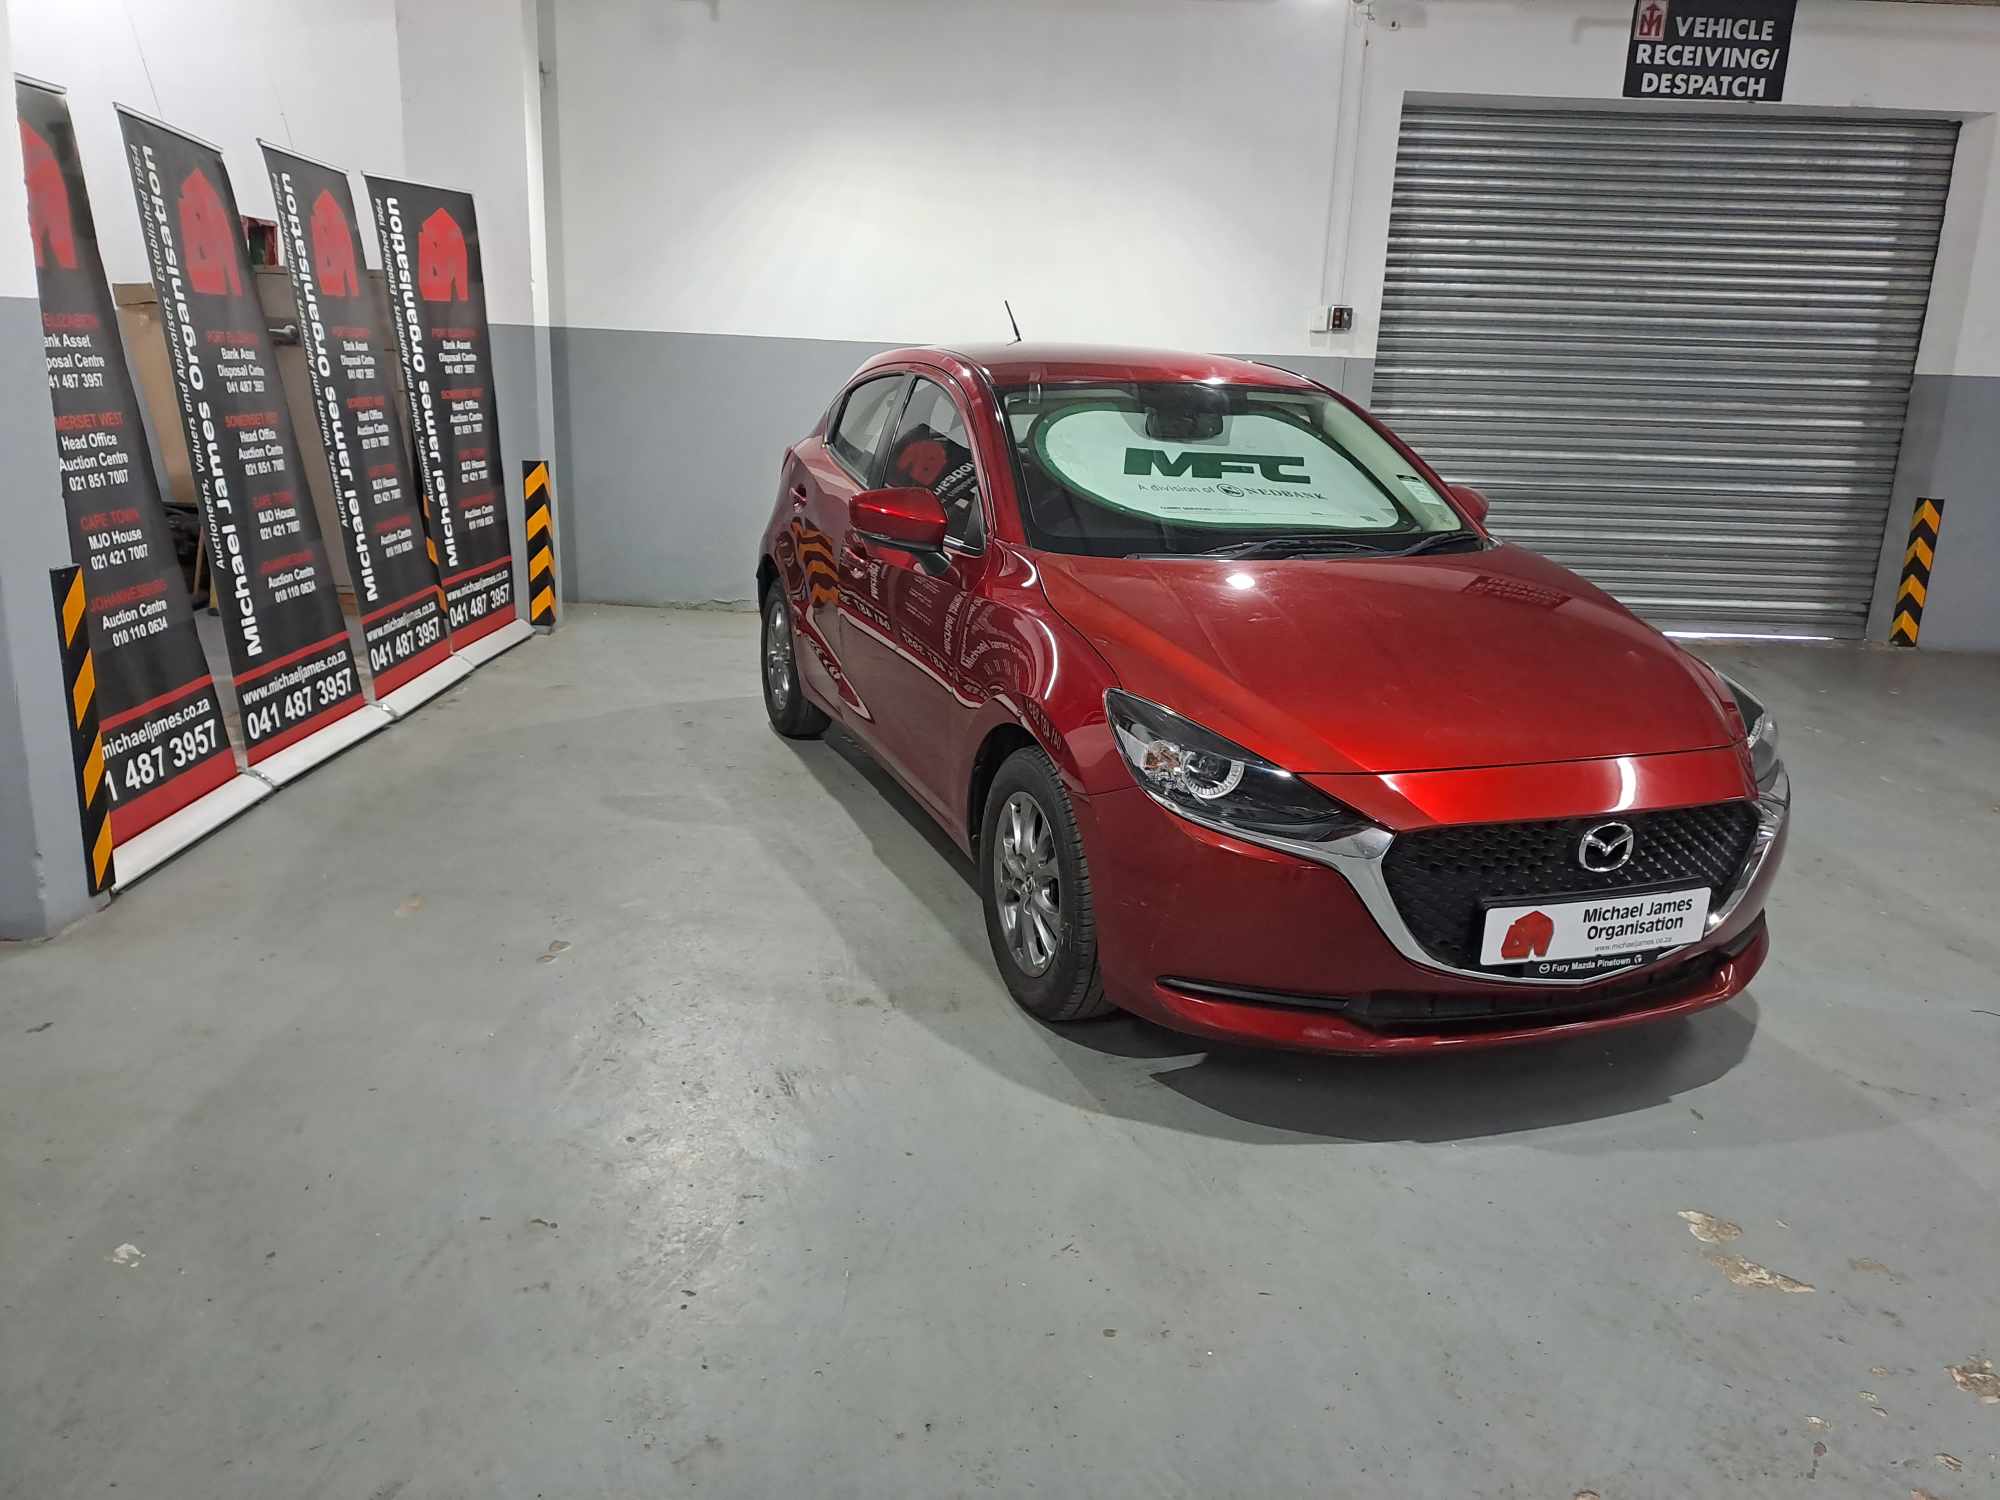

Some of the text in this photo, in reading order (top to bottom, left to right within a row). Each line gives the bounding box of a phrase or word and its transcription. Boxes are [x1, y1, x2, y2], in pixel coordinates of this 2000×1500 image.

[1676, 16, 1775, 41] VEHICLE
[1636, 44, 1780, 70] RECEIVING/
[1641, 73, 1766, 97] DESPATCH
[281, 172, 331, 378] Organisation
[44, 333, 92, 348] ank Asset
[163, 295, 187, 380] Appraisers
[46, 353, 105, 371] posal Centre
[48, 373, 104, 389] 41 487 3957
[386, 197, 459, 568] Michael James Organisation
[142, 144, 263, 657] Michael James Organisation
[178, 380, 194, 414] and
[60, 432, 118, 451] Head Office
[188, 416, 206, 473] Valuers
[324, 385, 354, 483] James
[60, 451, 129, 473] Auction Centre
[1124, 447, 1311, 484] MFC
[68, 469, 129, 492] 021 851 7007
[1244, 487, 1329, 501] NEDBANK
[88, 528, 143, 551] MJO House
[343, 489, 379, 602] Michael
[90, 543, 149, 571] 021 421 7007
[102, 599, 168, 636] Auction Centre
[449, 582, 510, 627] 041 487 3957
[112, 629, 130, 648] 010
[129, 623, 147, 641] 110
[370, 616, 440, 671] 041 487 3957
[246, 667, 353, 740] 041 487 3957
[102, 698, 211, 760] michaeljames.co.za
[125, 745, 165, 791] 487
[169, 718, 217, 768] 3957
[1583, 898, 1693, 923] Michael James
[1587, 915, 1684, 941] Organisation
[1551, 957, 1631, 974] Fury Mazda Pinetown
